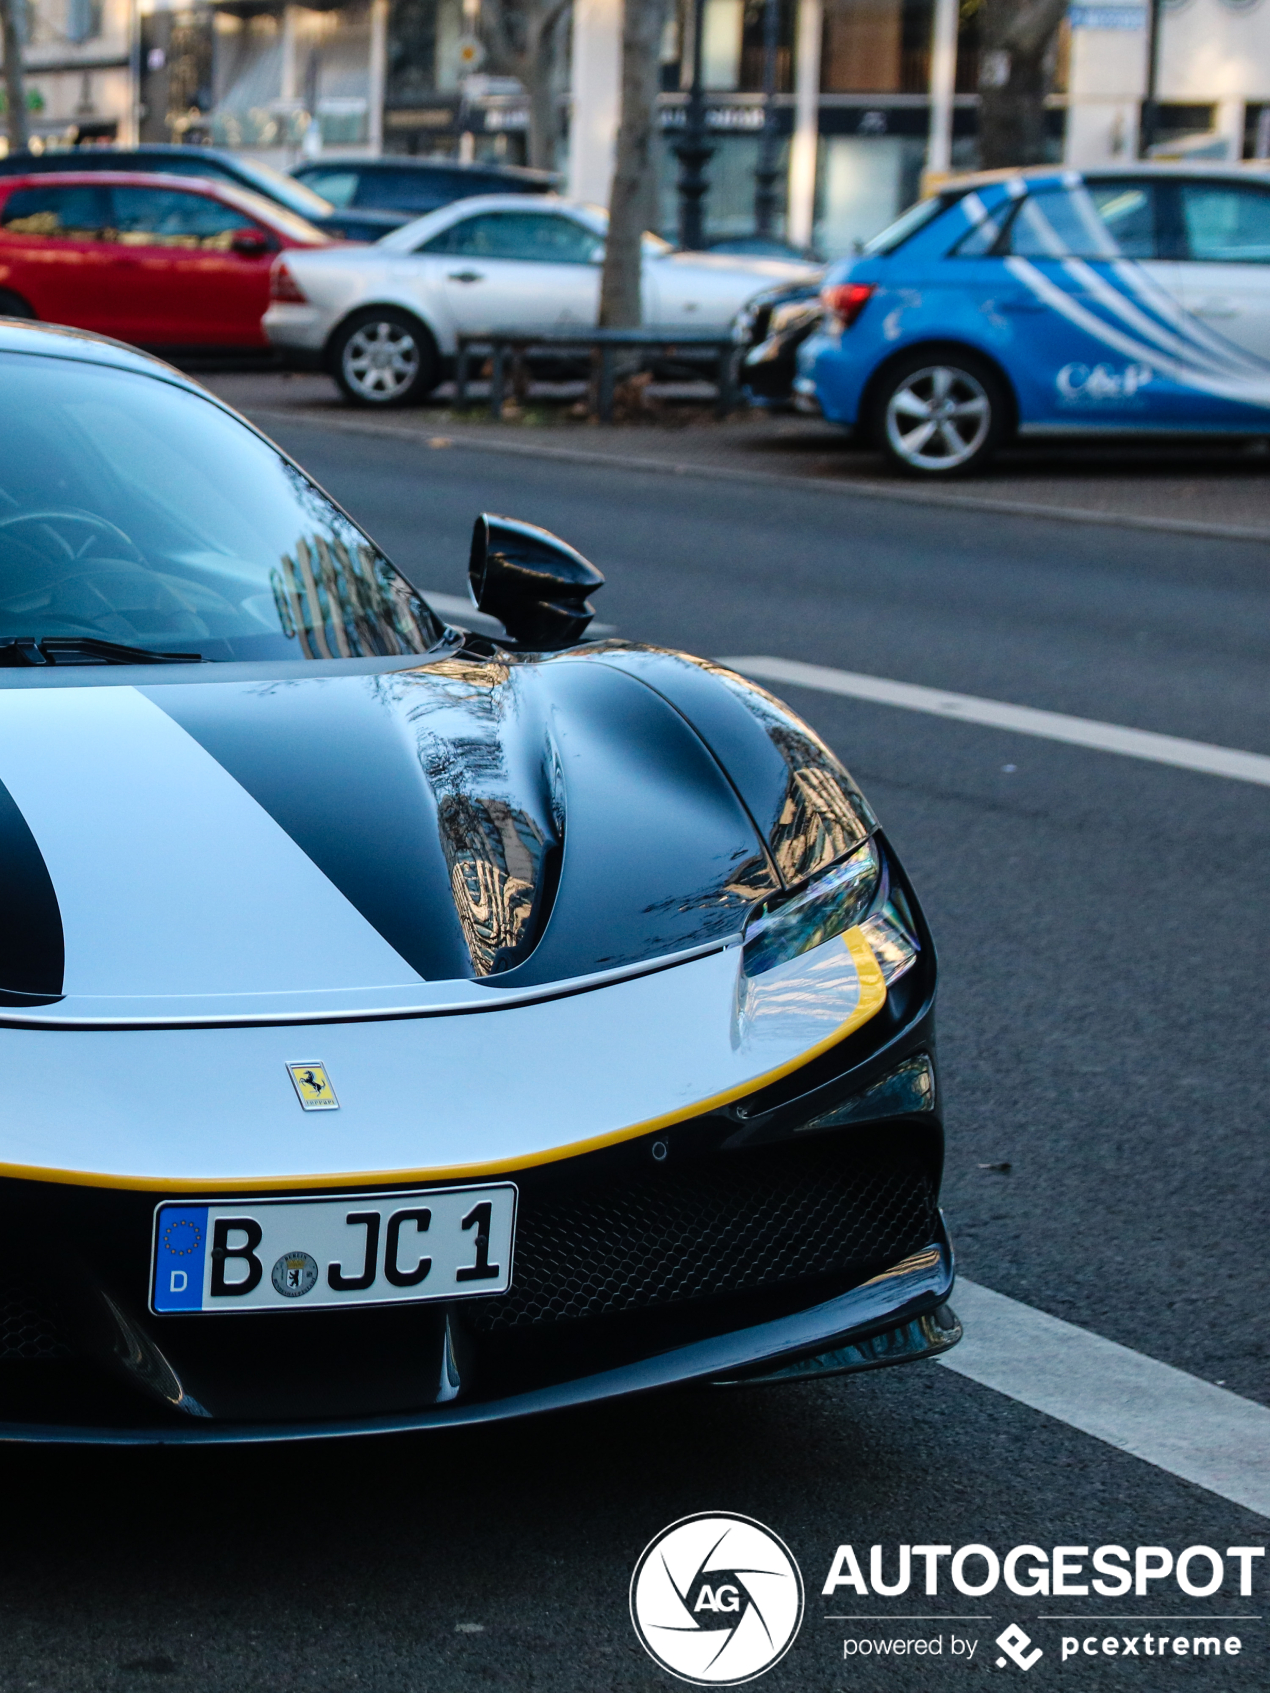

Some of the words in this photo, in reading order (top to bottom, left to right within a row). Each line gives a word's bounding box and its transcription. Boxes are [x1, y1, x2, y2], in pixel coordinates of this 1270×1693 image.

[211, 1217, 263, 1297] B
[328, 1210, 432, 1291] JC
[456, 1201, 500, 1282] 1
[170, 1271, 188, 1292] D
